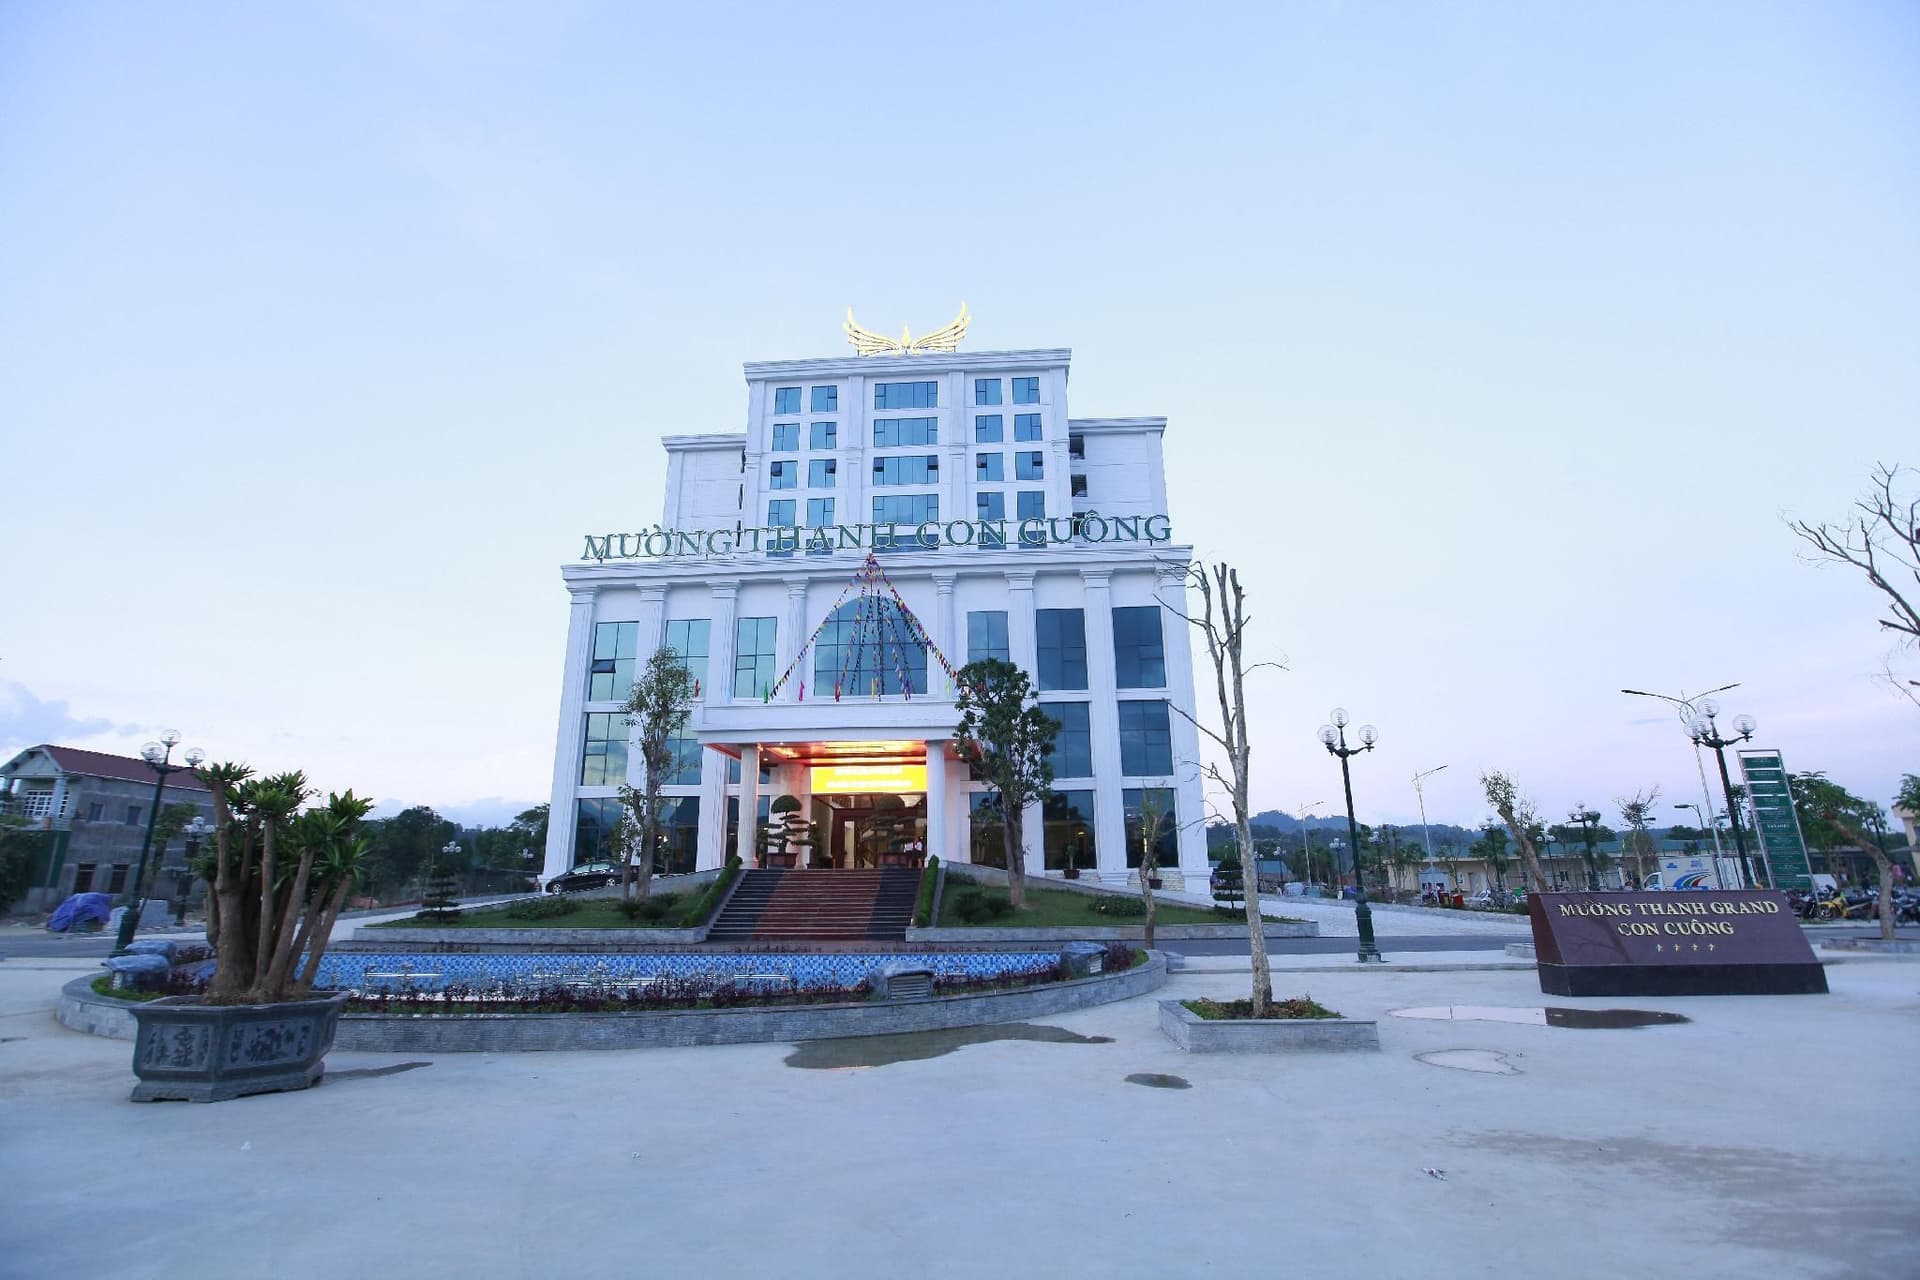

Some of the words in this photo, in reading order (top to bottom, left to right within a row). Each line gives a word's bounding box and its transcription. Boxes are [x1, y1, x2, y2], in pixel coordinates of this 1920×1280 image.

[581, 523, 733, 560] MƯỜNG
[744, 521, 898, 552] THANH
[915, 519, 1007, 548] CON
[1018, 509, 1172, 545] CUÔNG
[1635, 902, 1708, 916] THANH
[1710, 901, 1779, 914] GRAND
[1617, 922, 1660, 936] CON
[1663, 918, 1735, 935] CUÔNG
